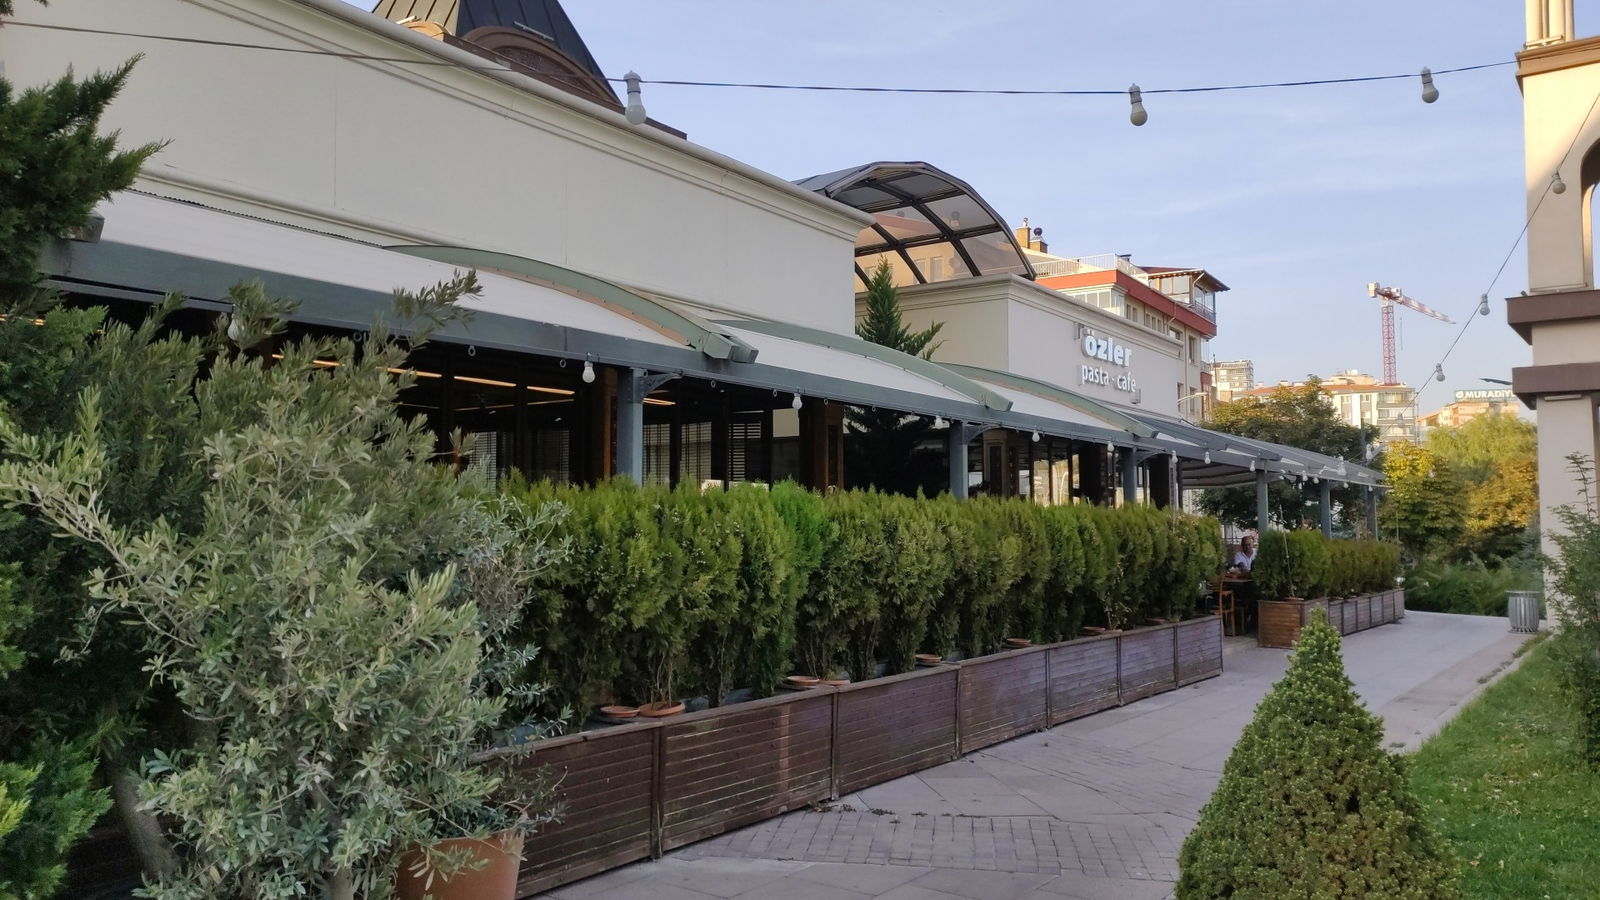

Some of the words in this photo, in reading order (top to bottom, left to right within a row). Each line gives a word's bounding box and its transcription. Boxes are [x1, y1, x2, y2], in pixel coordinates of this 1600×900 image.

[1084, 328, 1132, 366] özler
[1081, 364, 1109, 385] pasta
[1117, 371, 1137, 393] cafe
